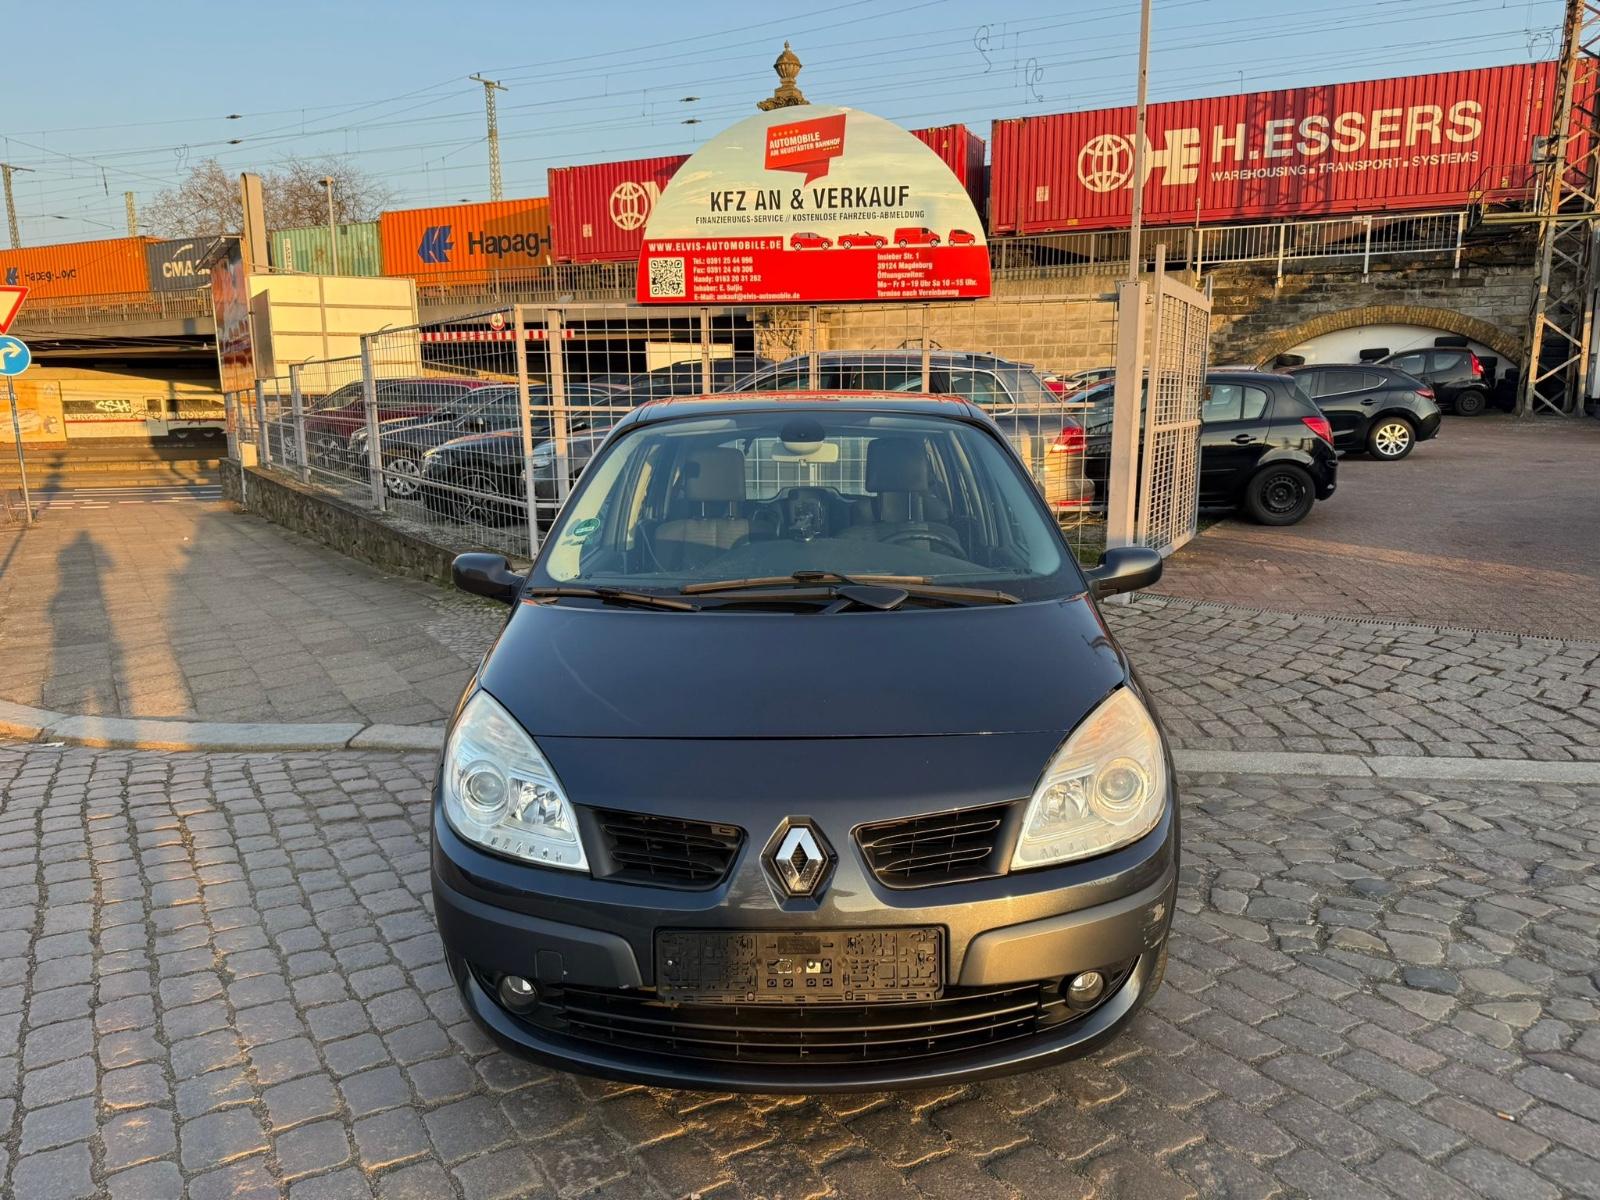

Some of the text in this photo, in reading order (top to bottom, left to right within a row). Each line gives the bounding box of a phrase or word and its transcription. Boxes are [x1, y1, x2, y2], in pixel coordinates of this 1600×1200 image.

[1212, 100, 1482, 164] H.ESSERS
[769, 131, 820, 149] AUTOMOBILE
[815, 138, 841, 149] BAHNHOF
[1211, 151, 1479, 182] WAREHOUSING TRANSPORT SYSTEMS
[710, 185, 910, 212] KFZ AN & VERKAUF
[695, 214, 784, 224] FINANZIERUNGS-SERVICE
[792, 213, 837, 222] KOSTENLOSE
[839, 210, 925, 220] FAHRZEUG-ABMELDUNG
[648, 240, 782, 252] WWW.ELVIS-AUTOMOBILE.DE
[903, 252, 914, 260] Str.
[163, 260, 194, 278] CMA
[898, 261, 933, 270] Magdeburg
[877, 270, 925, 279] Öffnungszeiten:
[693, 284, 718, 292] Inhaber:
[893, 280, 900, 288] Fr
[919, 279, 931, 287] Uhr
[932, 279, 941, 287] Sa
[877, 289, 959, 298] Termine nach Vereinbarung
